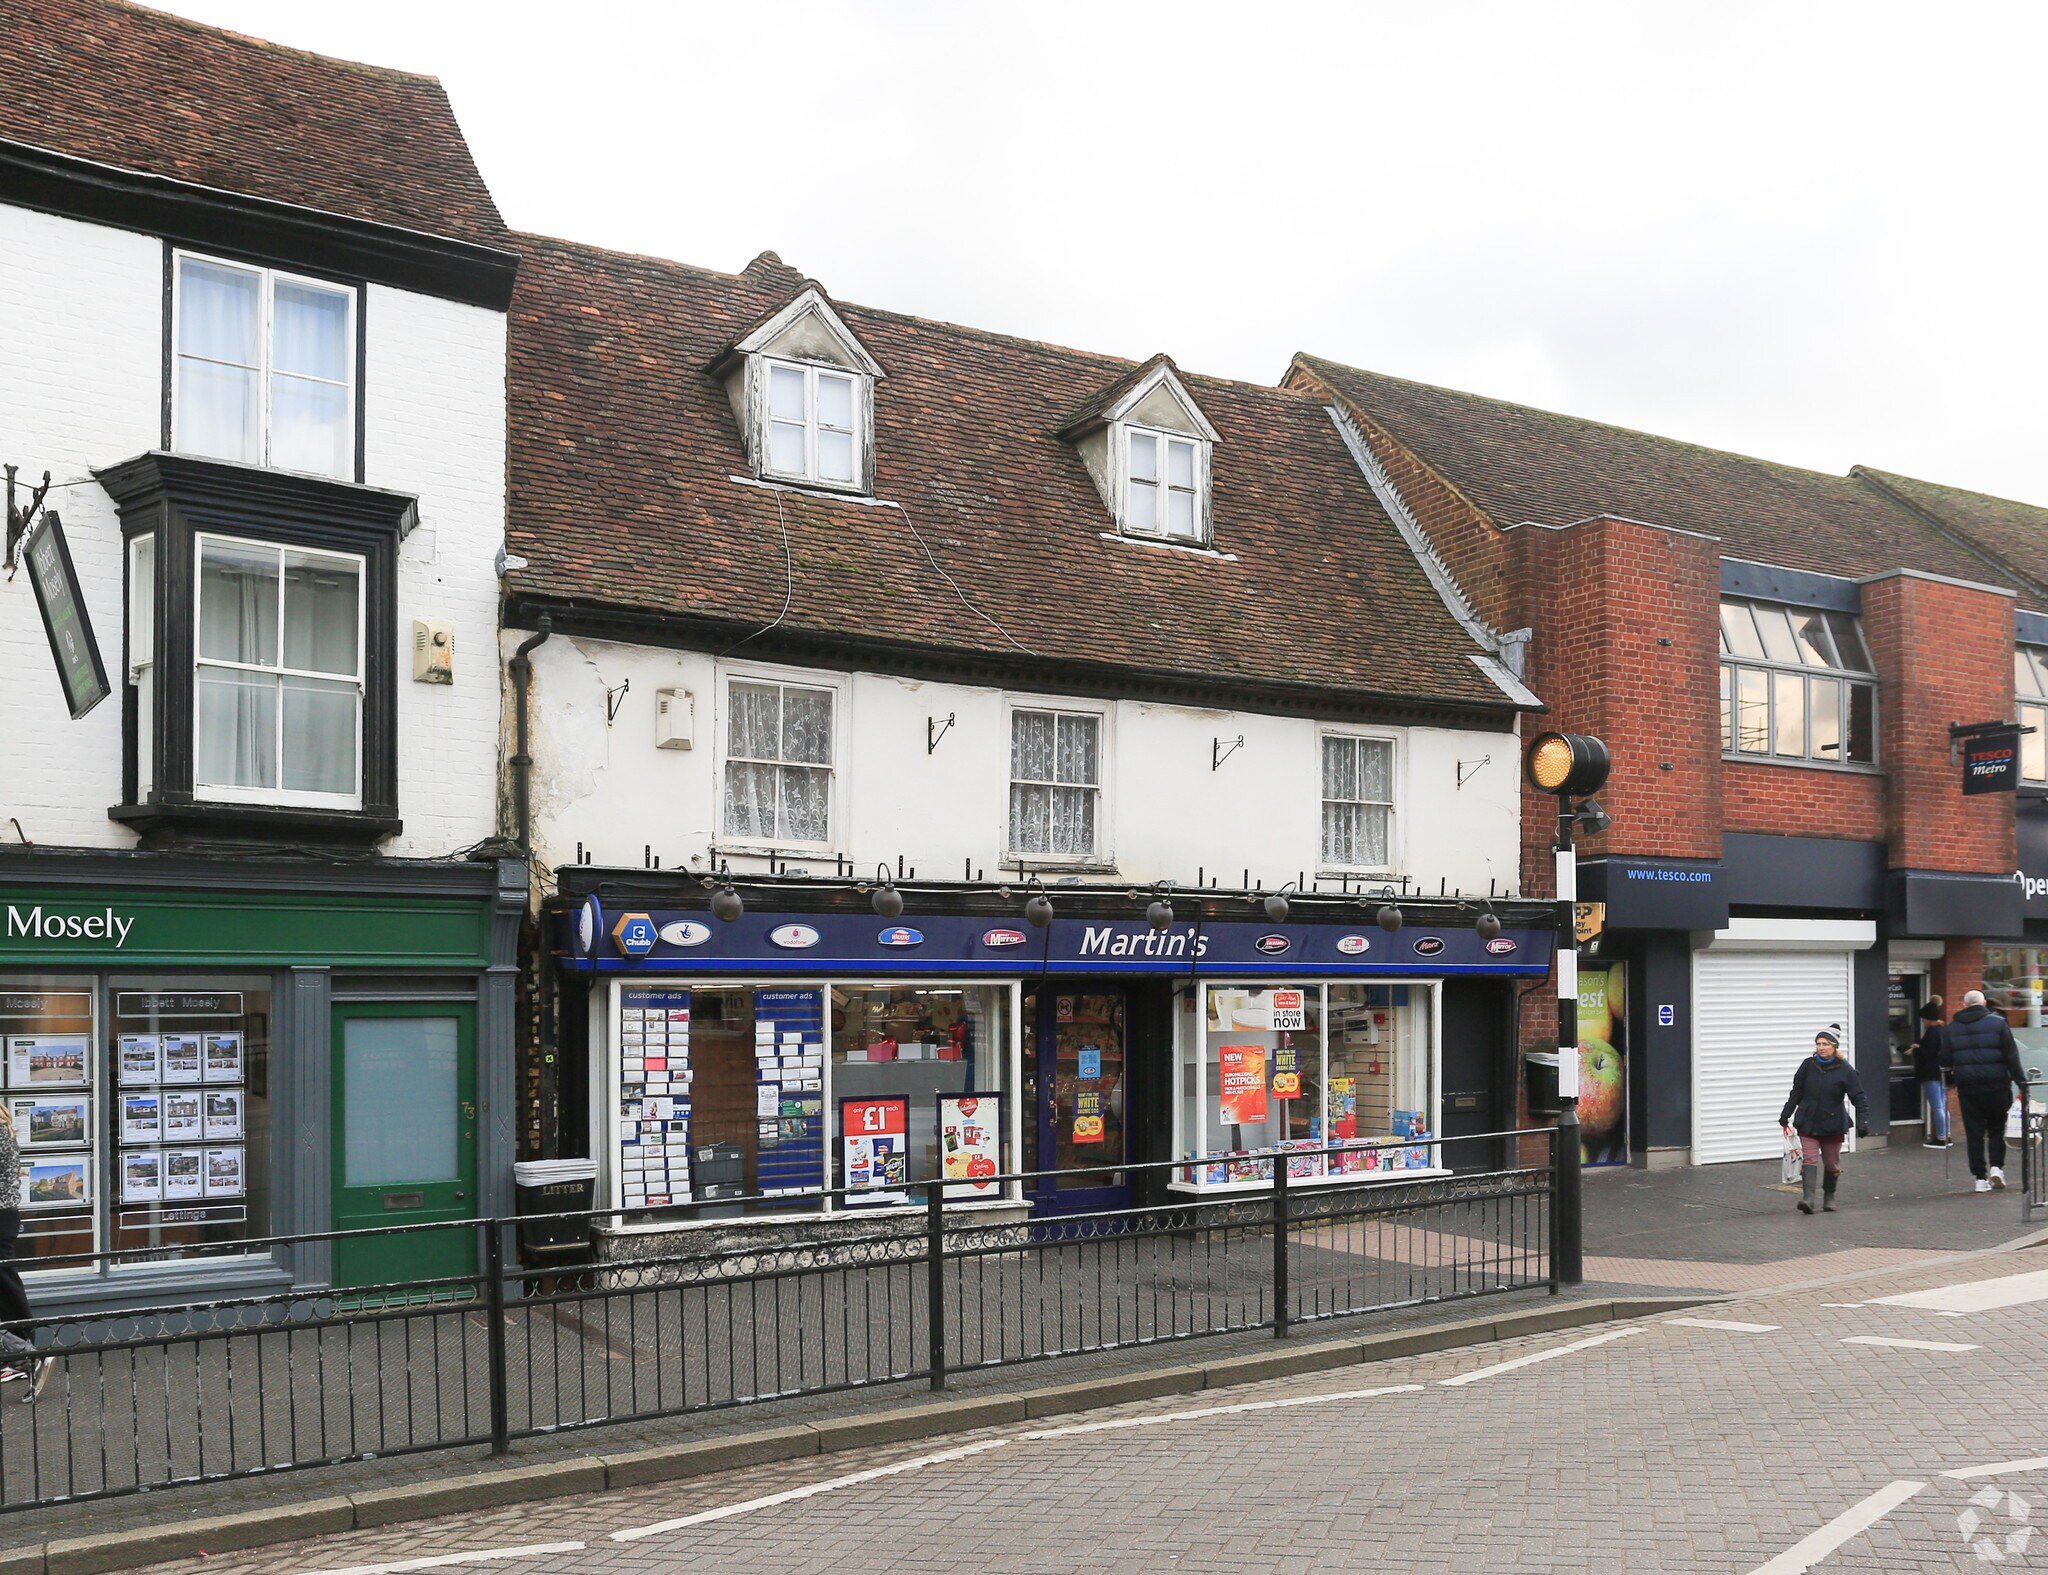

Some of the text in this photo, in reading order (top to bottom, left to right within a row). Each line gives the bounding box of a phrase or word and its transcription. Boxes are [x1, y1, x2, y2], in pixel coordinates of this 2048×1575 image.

[36, 544, 55, 577] Ibbett
[42, 567, 65, 604] Mosely
[1971, 749, 2013, 762] TESCO
[1973, 763, 2007, 776] Metro
[1627, 869, 1712, 882] www.tesco.com
[2013, 869, 2048, 900] Ope
[7, 905, 135, 948] Mosely
[626, 938, 652, 946] Chubb
[990, 933, 1019, 945] Mirror
[1079, 926, 1209, 957] Martin's
[1490, 941, 1512, 953] Mirror
[628, 992, 682, 1000] customer ads
[762, 991, 813, 1000] customer ads
[1577, 989, 1605, 1007] est
[6, 997, 48, 1009] Mosely
[142, 997, 220, 1009] Ibbett Mosely
[1273, 1009, 1301, 1017] in store
[1273, 1017, 1301, 1028] now
[1224, 1053, 1243, 1061] NEW
[1276, 1055, 1296, 1065] WHITE
[1224, 1076, 1261, 1085] HOTPICKS
[1077, 1097, 1099, 1108] WHITE
[461, 1102, 475, 1119] 73
[863, 1106, 886, 1130] £1
[543, 1184, 584, 1195] LITTER
[161, 1210, 206, 1221] Lettings
